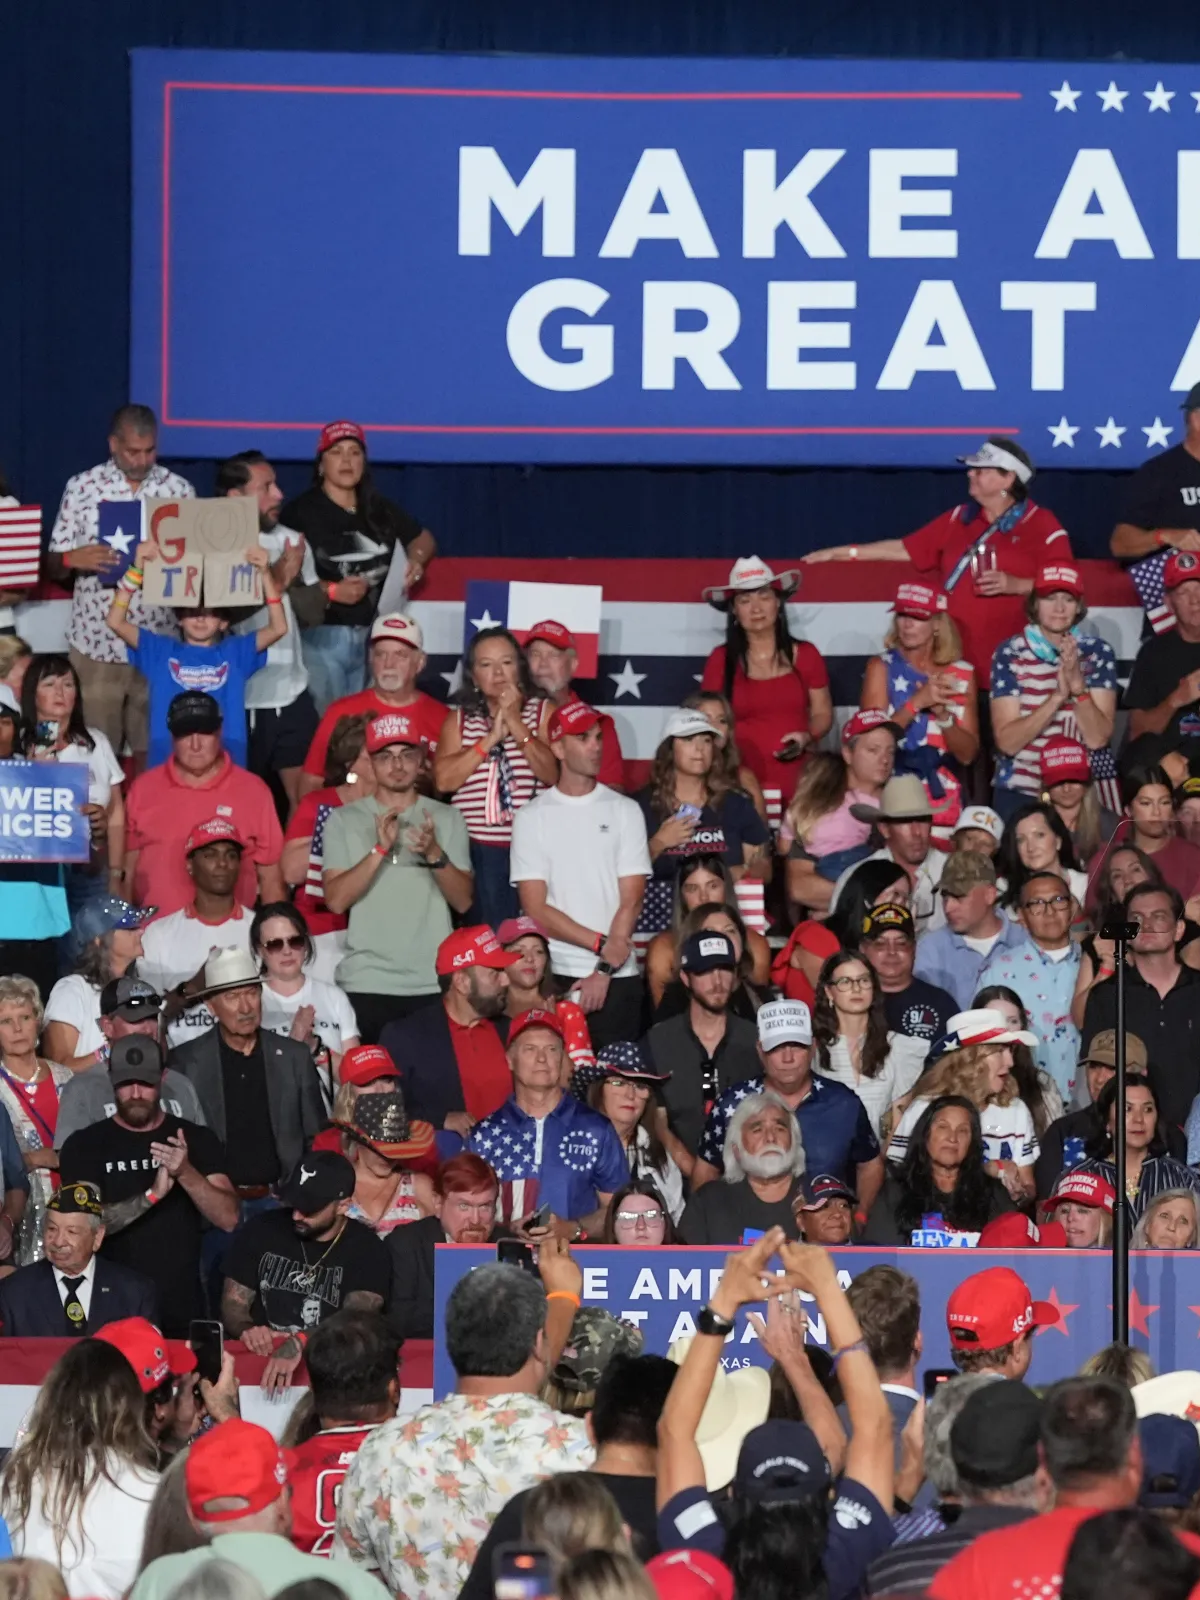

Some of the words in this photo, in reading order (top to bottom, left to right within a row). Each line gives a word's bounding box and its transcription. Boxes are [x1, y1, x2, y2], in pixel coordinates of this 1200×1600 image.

[458, 145, 958, 258] MAKE
[506, 277, 1096, 391] GREAT
[372, 715, 410, 731] TRUMP
[0, 787, 75, 811] WER
[0, 813, 72, 838] ICES
[972, 811, 997, 829] CK
[453, 949, 475, 967] 45-47
[568, 1143, 593, 1157] 1776
[950, 1313, 979, 1323] TRUMP
